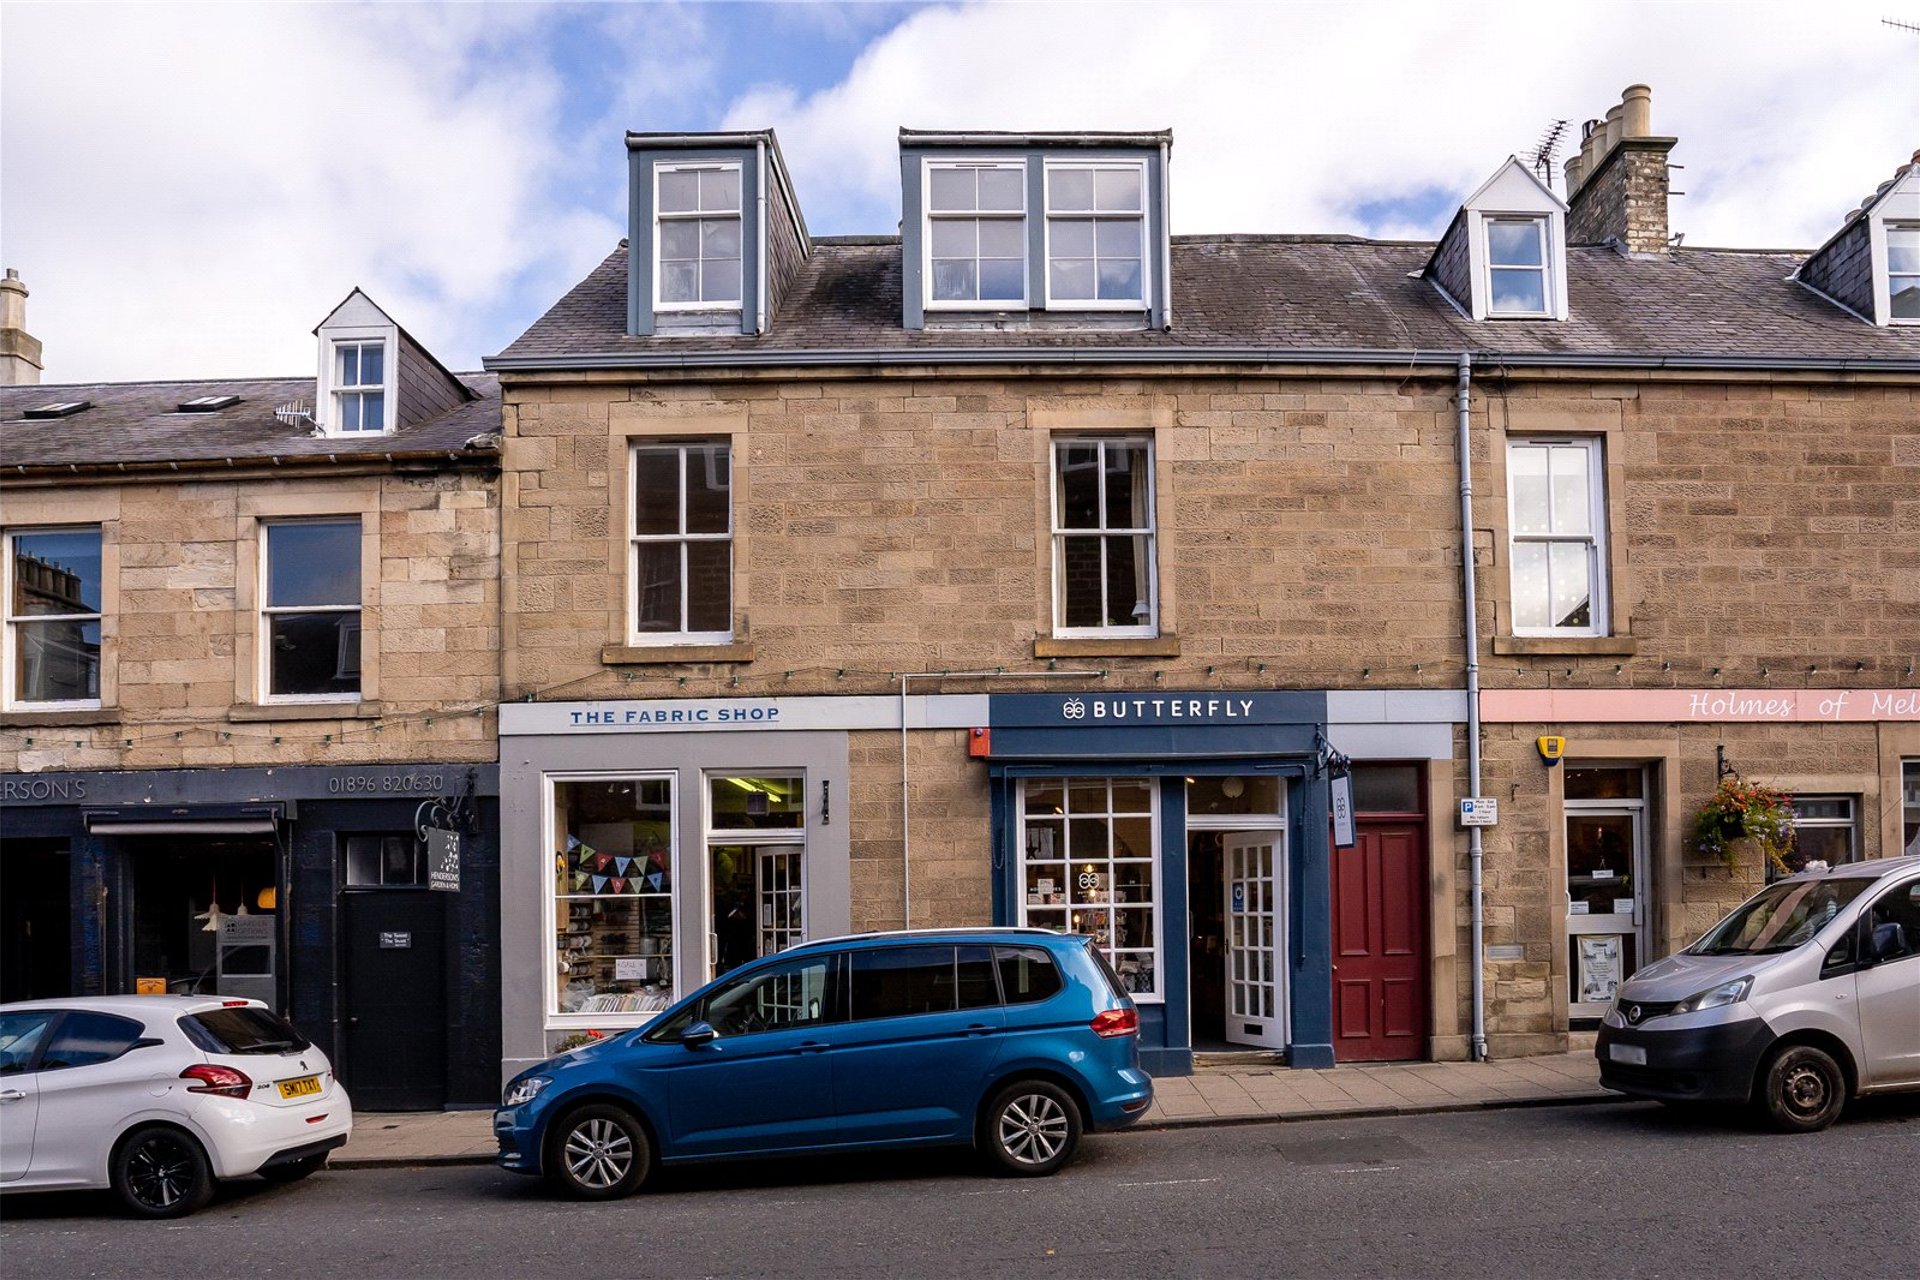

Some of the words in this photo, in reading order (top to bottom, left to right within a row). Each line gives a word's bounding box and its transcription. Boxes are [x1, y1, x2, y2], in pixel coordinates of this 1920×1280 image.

[1093, 699, 1254, 718] BUTTERFLY
[1689, 691, 1795, 717] Holmes
[1818, 690, 1850, 719] of
[570, 711, 615, 724] THE
[625, 709, 709, 723] FABRIC
[717, 707, 779, 721] SHOP
[328, 776, 376, 793] 01896
[382, 774, 443, 791] 820630
